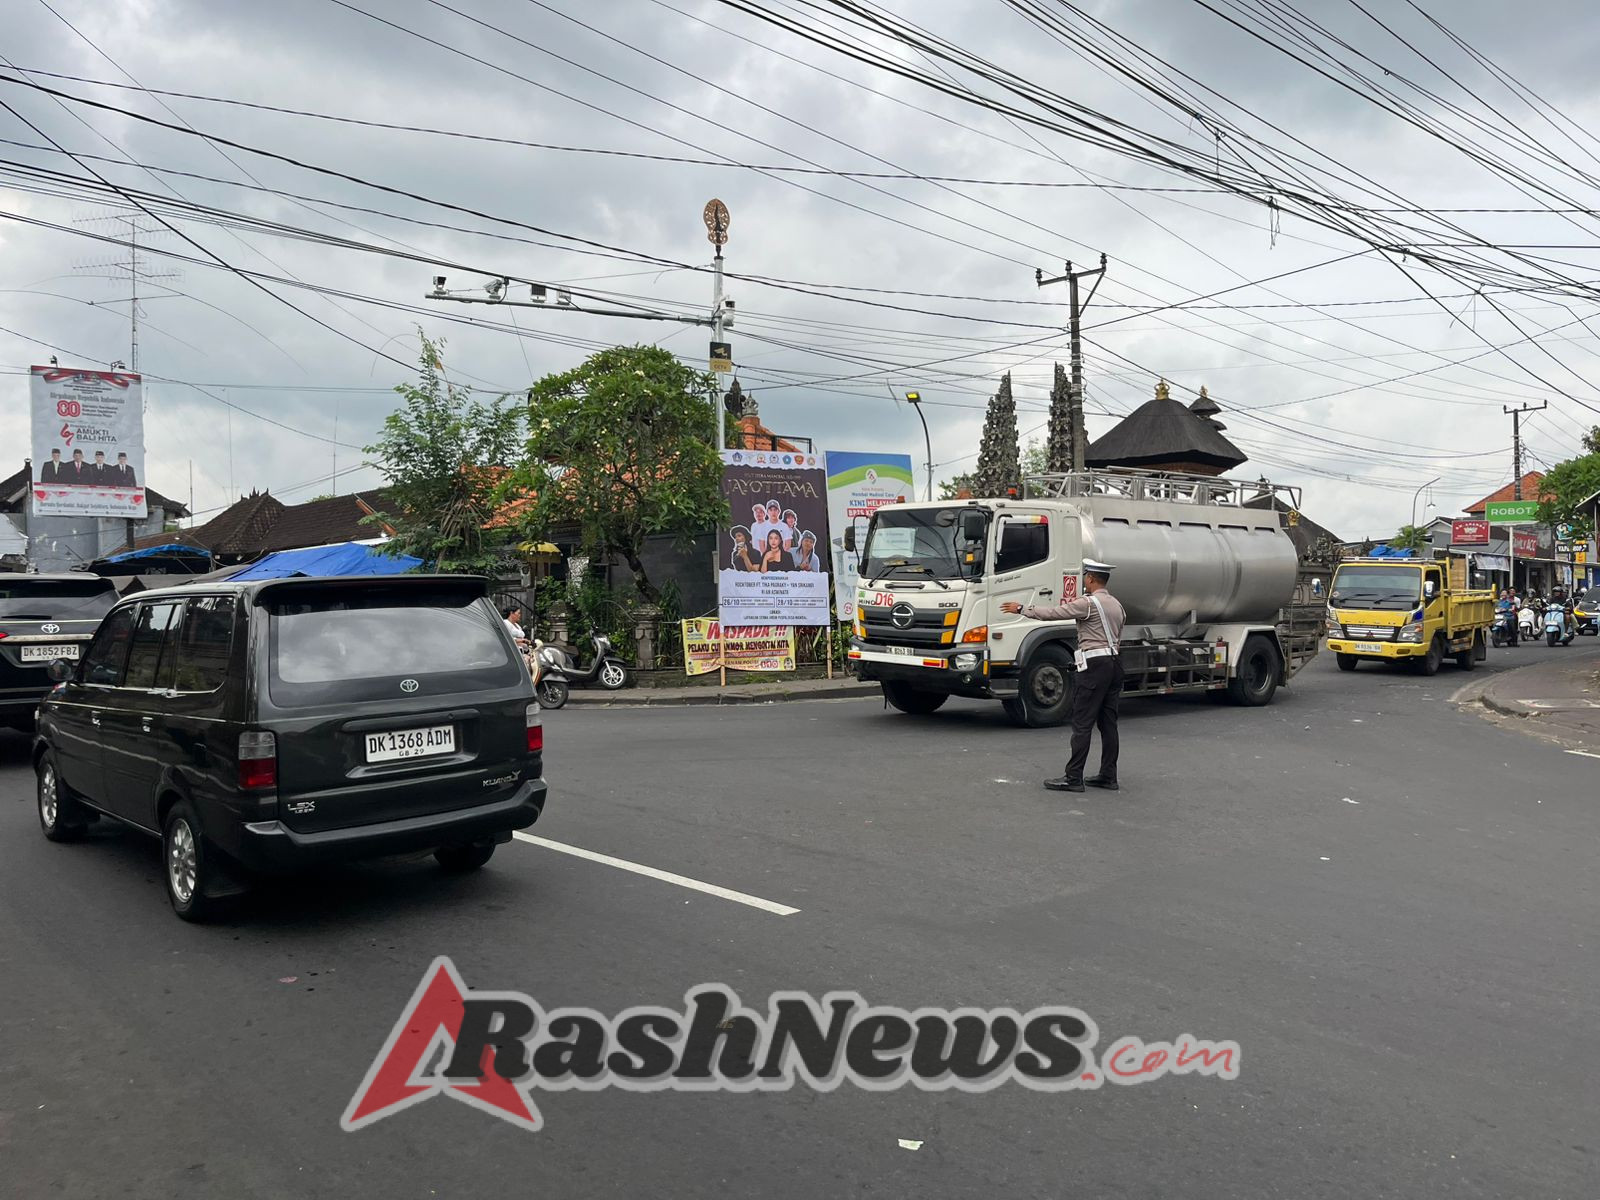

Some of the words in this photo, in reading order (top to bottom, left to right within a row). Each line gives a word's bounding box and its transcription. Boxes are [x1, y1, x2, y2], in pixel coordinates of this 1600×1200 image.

[57, 400, 80, 417] 80
[76, 428, 109, 436] AMUKTI
[1490, 506, 1533, 515] ROBOT
[875, 592, 895, 607] D16
[23, 647, 35, 657] DK
[36, 647, 60, 656] 1852
[60, 646, 78, 656] FBZ
[688, 643, 709, 653] PELAKU
[776, 640, 790, 649] KITA
[369, 735, 386, 754] DK
[388, 731, 424, 751] 1368
[426, 728, 452, 747] ADM
